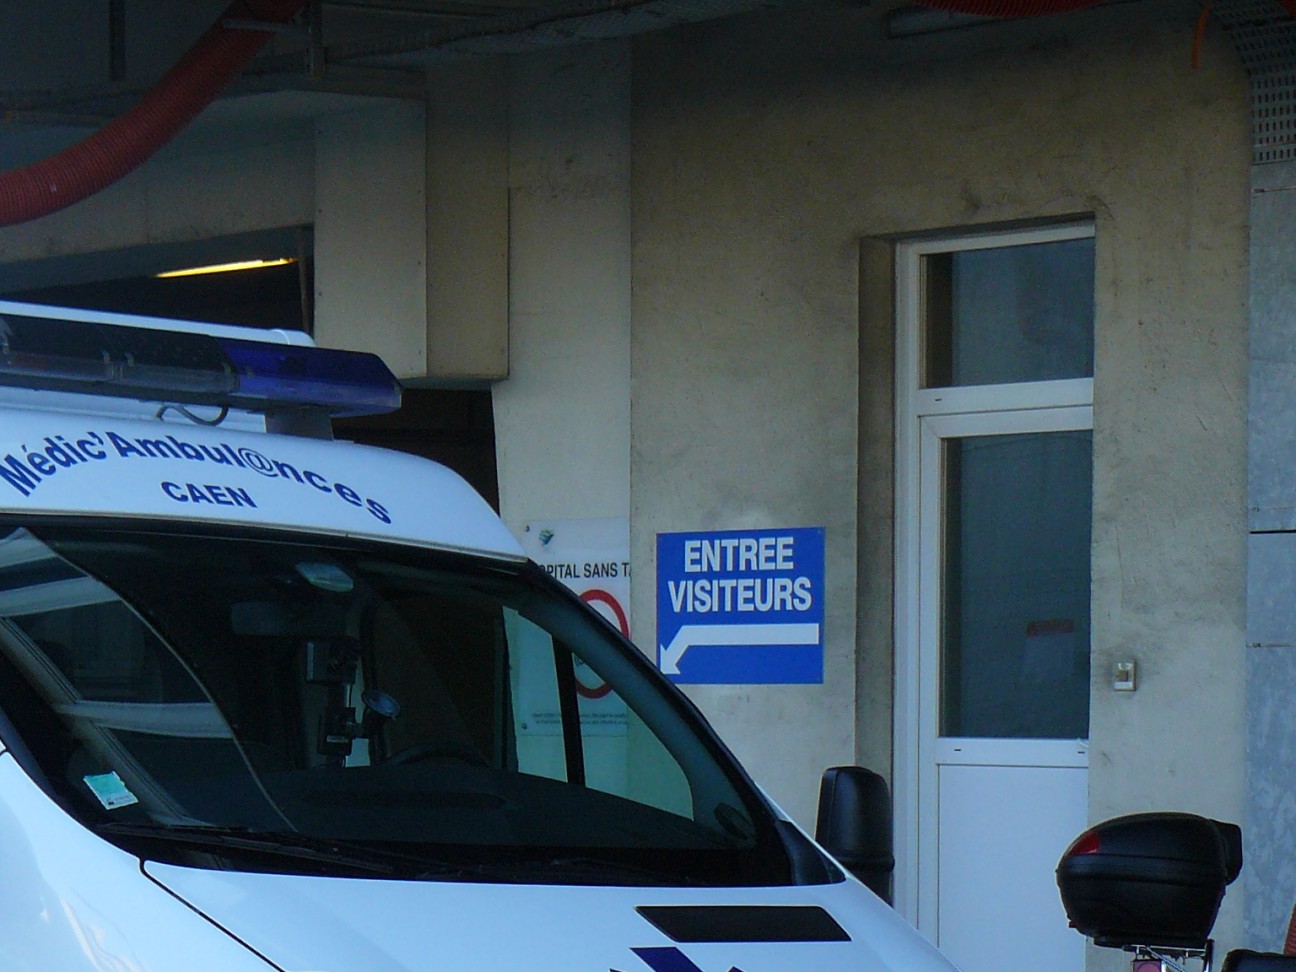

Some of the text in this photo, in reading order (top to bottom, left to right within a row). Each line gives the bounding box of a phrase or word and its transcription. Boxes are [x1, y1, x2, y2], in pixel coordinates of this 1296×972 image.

[160, 480, 258, 509] CAEN
[538, 562, 631, 579] PITAL SANS T
[684, 536, 794, 573] ENTREE
[667, 577, 812, 613] VISITEURS
